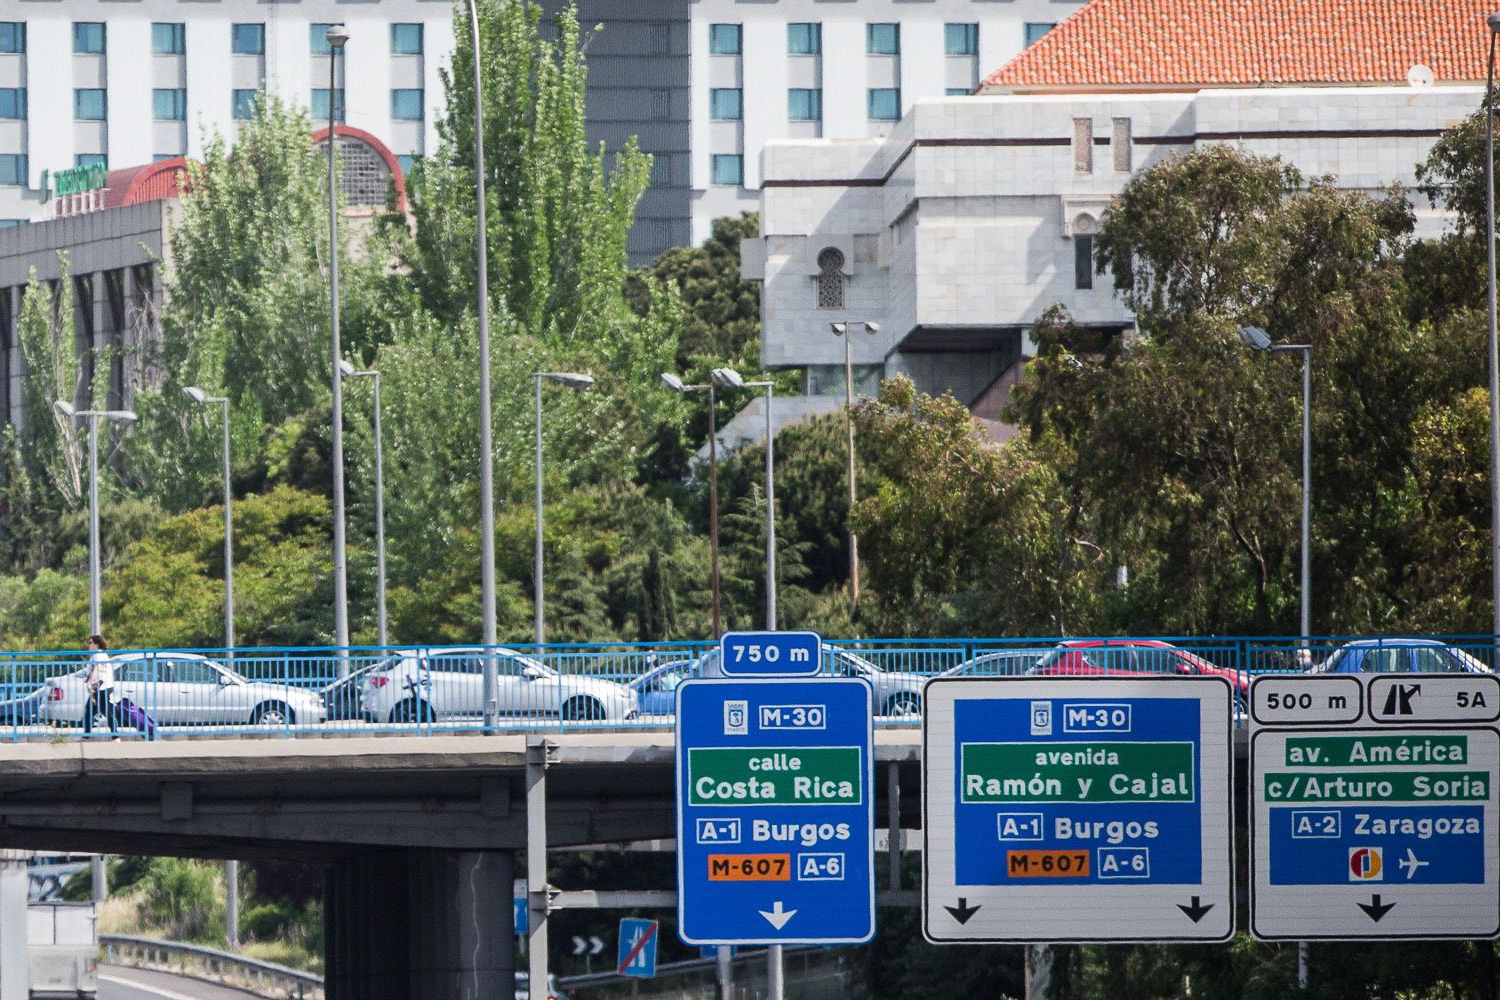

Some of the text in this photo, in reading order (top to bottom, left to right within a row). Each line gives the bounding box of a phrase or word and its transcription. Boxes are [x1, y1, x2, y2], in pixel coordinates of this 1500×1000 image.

[732, 645, 809, 662] 750 m
[1267, 693, 1346, 709] 500 m
[1456, 691, 1487, 708] 5A
[763, 708, 821, 726] M-30
[1068, 709, 1125, 727] M-30
[1035, 748, 1119, 766] avenida
[1289, 739, 1463, 763] av. América
[749, 753, 802, 771] calle
[695, 776, 854, 799] Costa Rica
[966, 772, 1188, 799] Ramón y Cajal
[1267, 775, 1485, 799] c/Arturo Soria
[701, 819, 850, 847] A-1 Burgos
[1002, 817, 1159, 845] A-1 Burgos
[1297, 814, 1480, 840] A-2 Zaragoza
[712, 857, 840, 876] M-607 A-6
[1010, 854, 1145, 872] M-607 A-6
